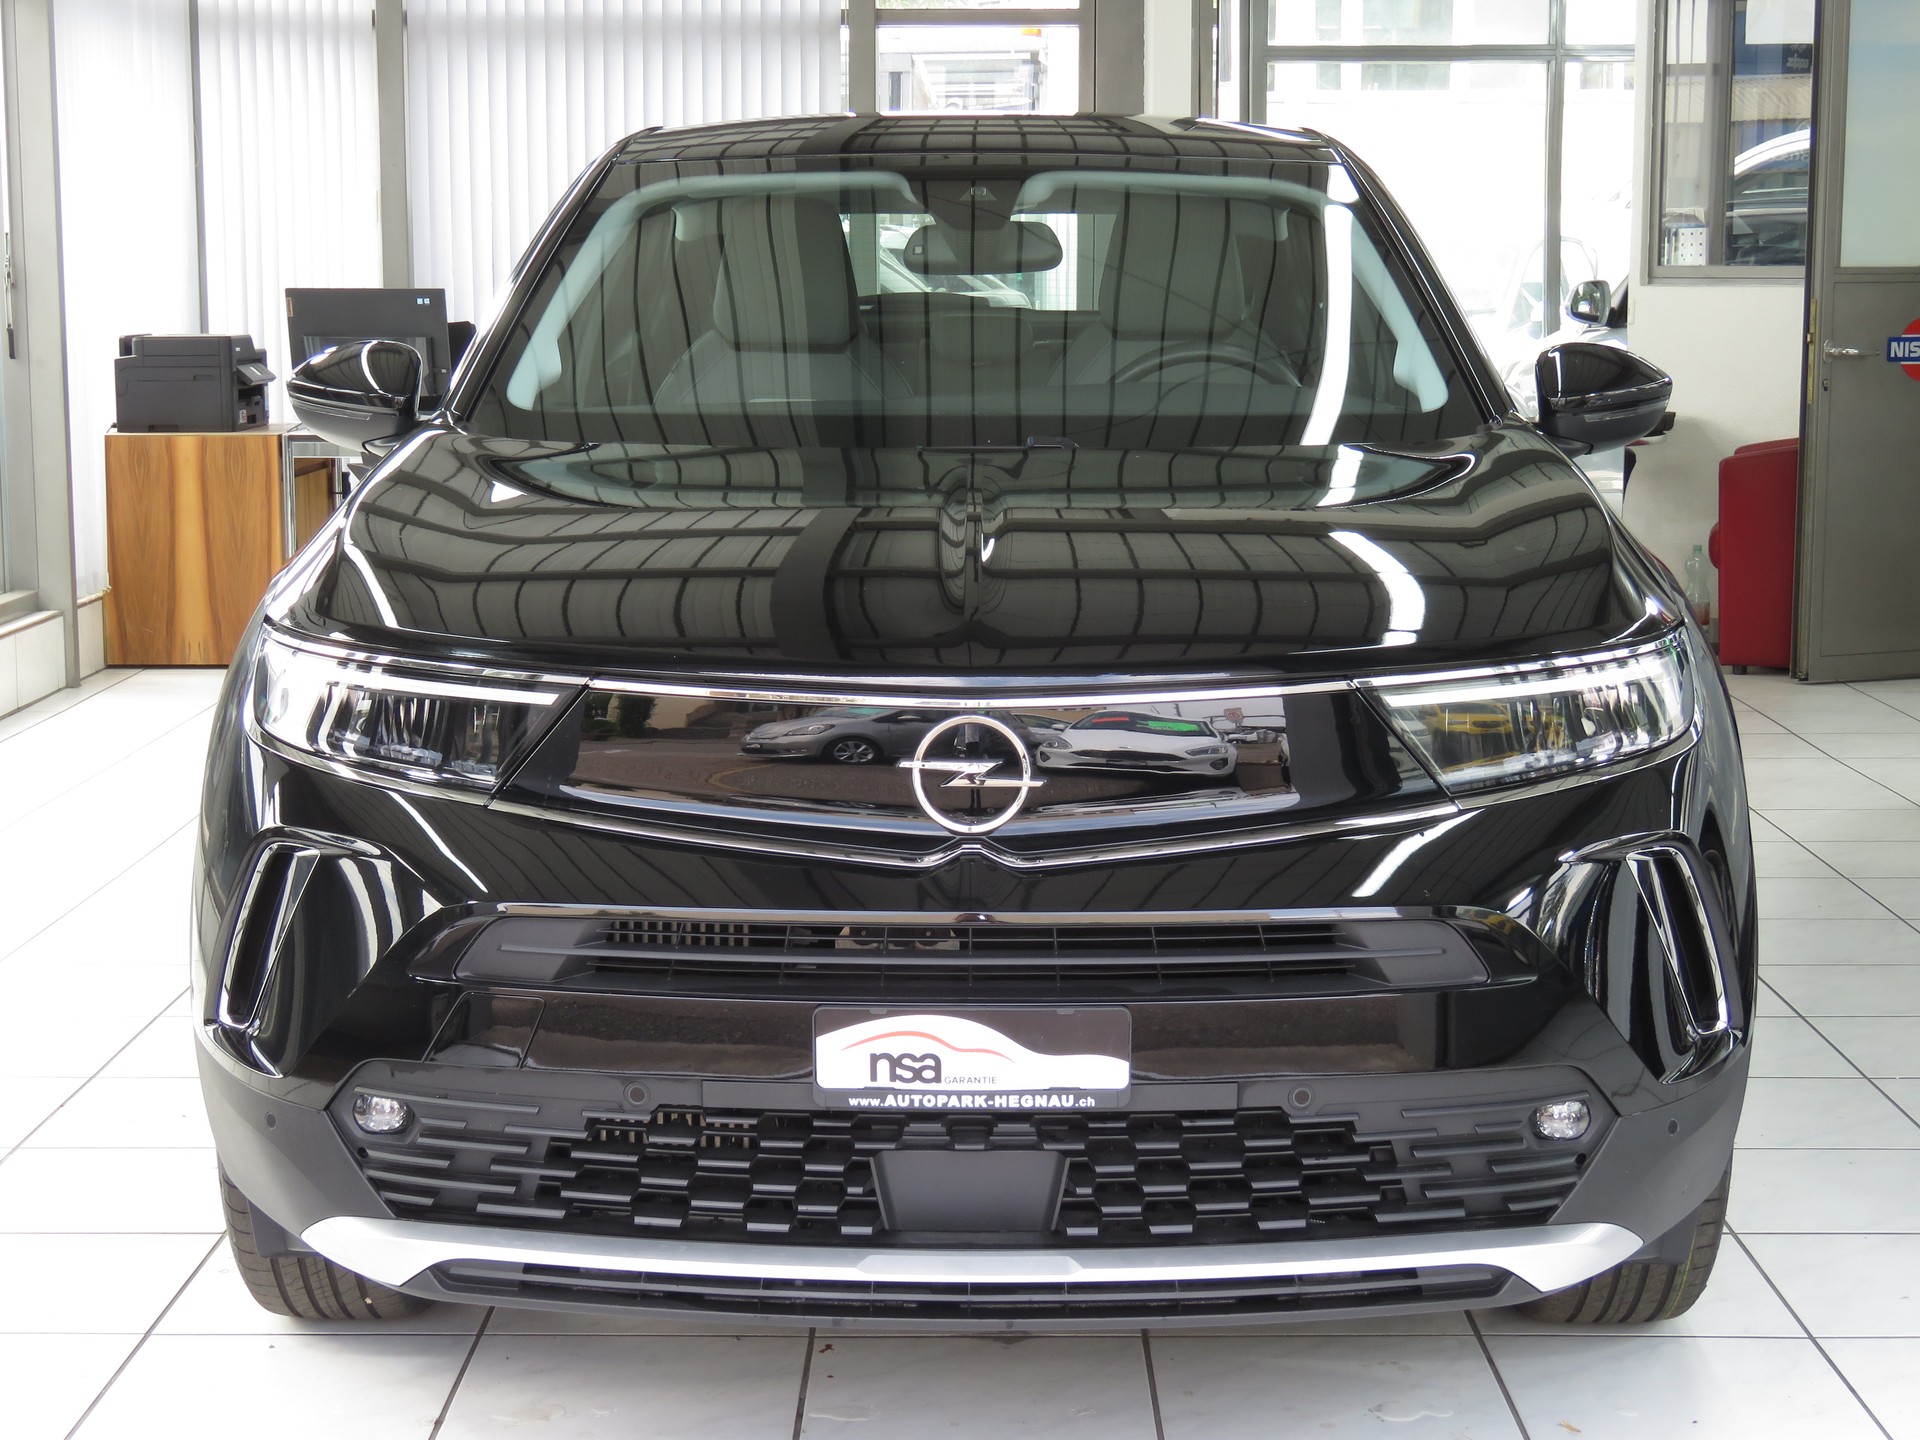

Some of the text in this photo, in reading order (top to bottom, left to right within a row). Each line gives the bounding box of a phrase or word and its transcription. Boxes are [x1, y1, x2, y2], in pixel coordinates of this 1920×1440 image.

[869, 1052, 998, 1085] nsa GARANTIE
[848, 1094, 1096, 1108] www.AUTOPARK-HEGNAU.ch
